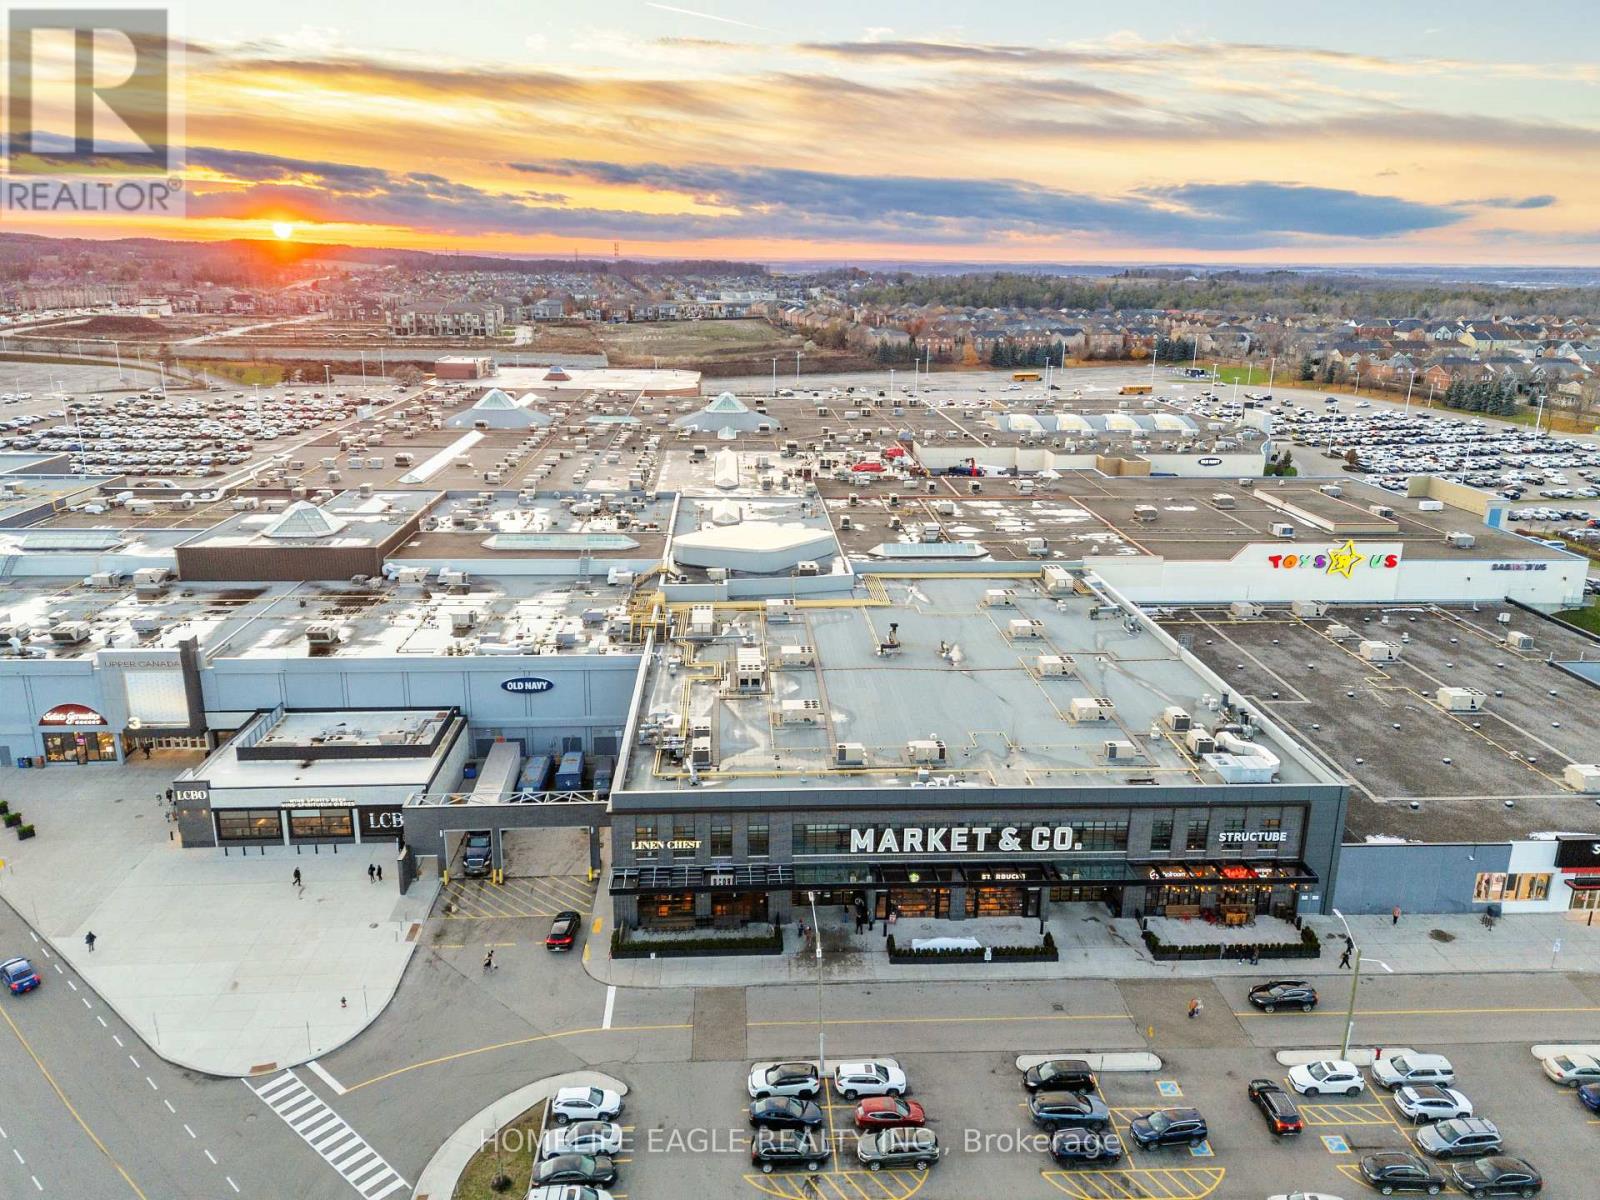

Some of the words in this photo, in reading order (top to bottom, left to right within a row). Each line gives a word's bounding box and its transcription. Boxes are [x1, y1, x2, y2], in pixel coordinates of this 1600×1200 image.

[1268, 554, 1327, 569] TOYS
[1369, 554, 1398, 569] US
[137, 660, 181, 668] CANADA
[507, 681, 523, 690] OLD
[524, 681, 548, 690] NAVY
[176, 790, 207, 800] LCBO
[368, 812, 405, 828] LCB
[850, 827, 992, 853] MARKET
[998, 826, 1023, 852] &
[1031, 826, 1082, 851] CO.
[1218, 831, 1288, 842] STRUCTUBE
[631, 840, 664, 850] LINEN
[666, 840, 702, 849] CHEST
